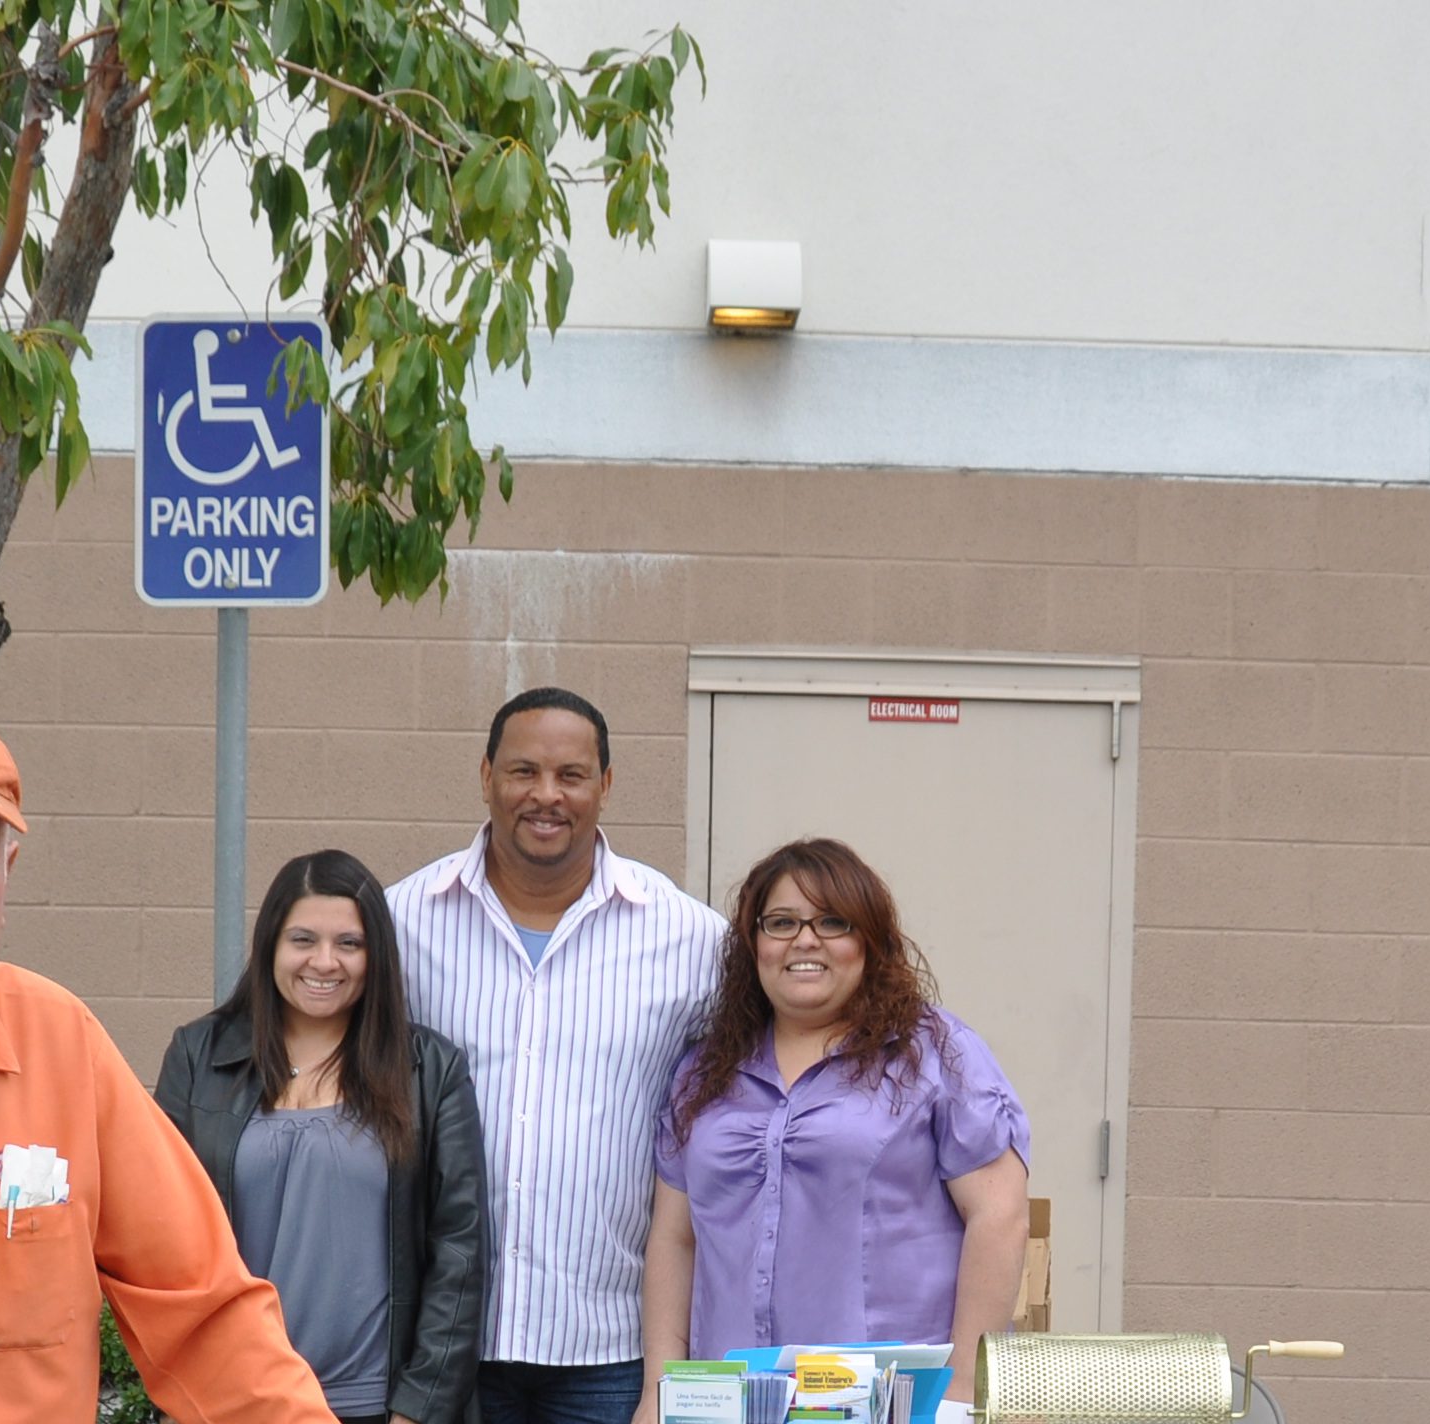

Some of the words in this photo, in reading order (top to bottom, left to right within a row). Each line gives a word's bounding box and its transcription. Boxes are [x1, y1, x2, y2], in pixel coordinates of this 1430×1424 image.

[150, 495, 315, 537] PARKING
[183, 547, 281, 589] ONLY
[871, 702, 927, 718] ELECTRICAL
[930, 704, 957, 718] ROOM
